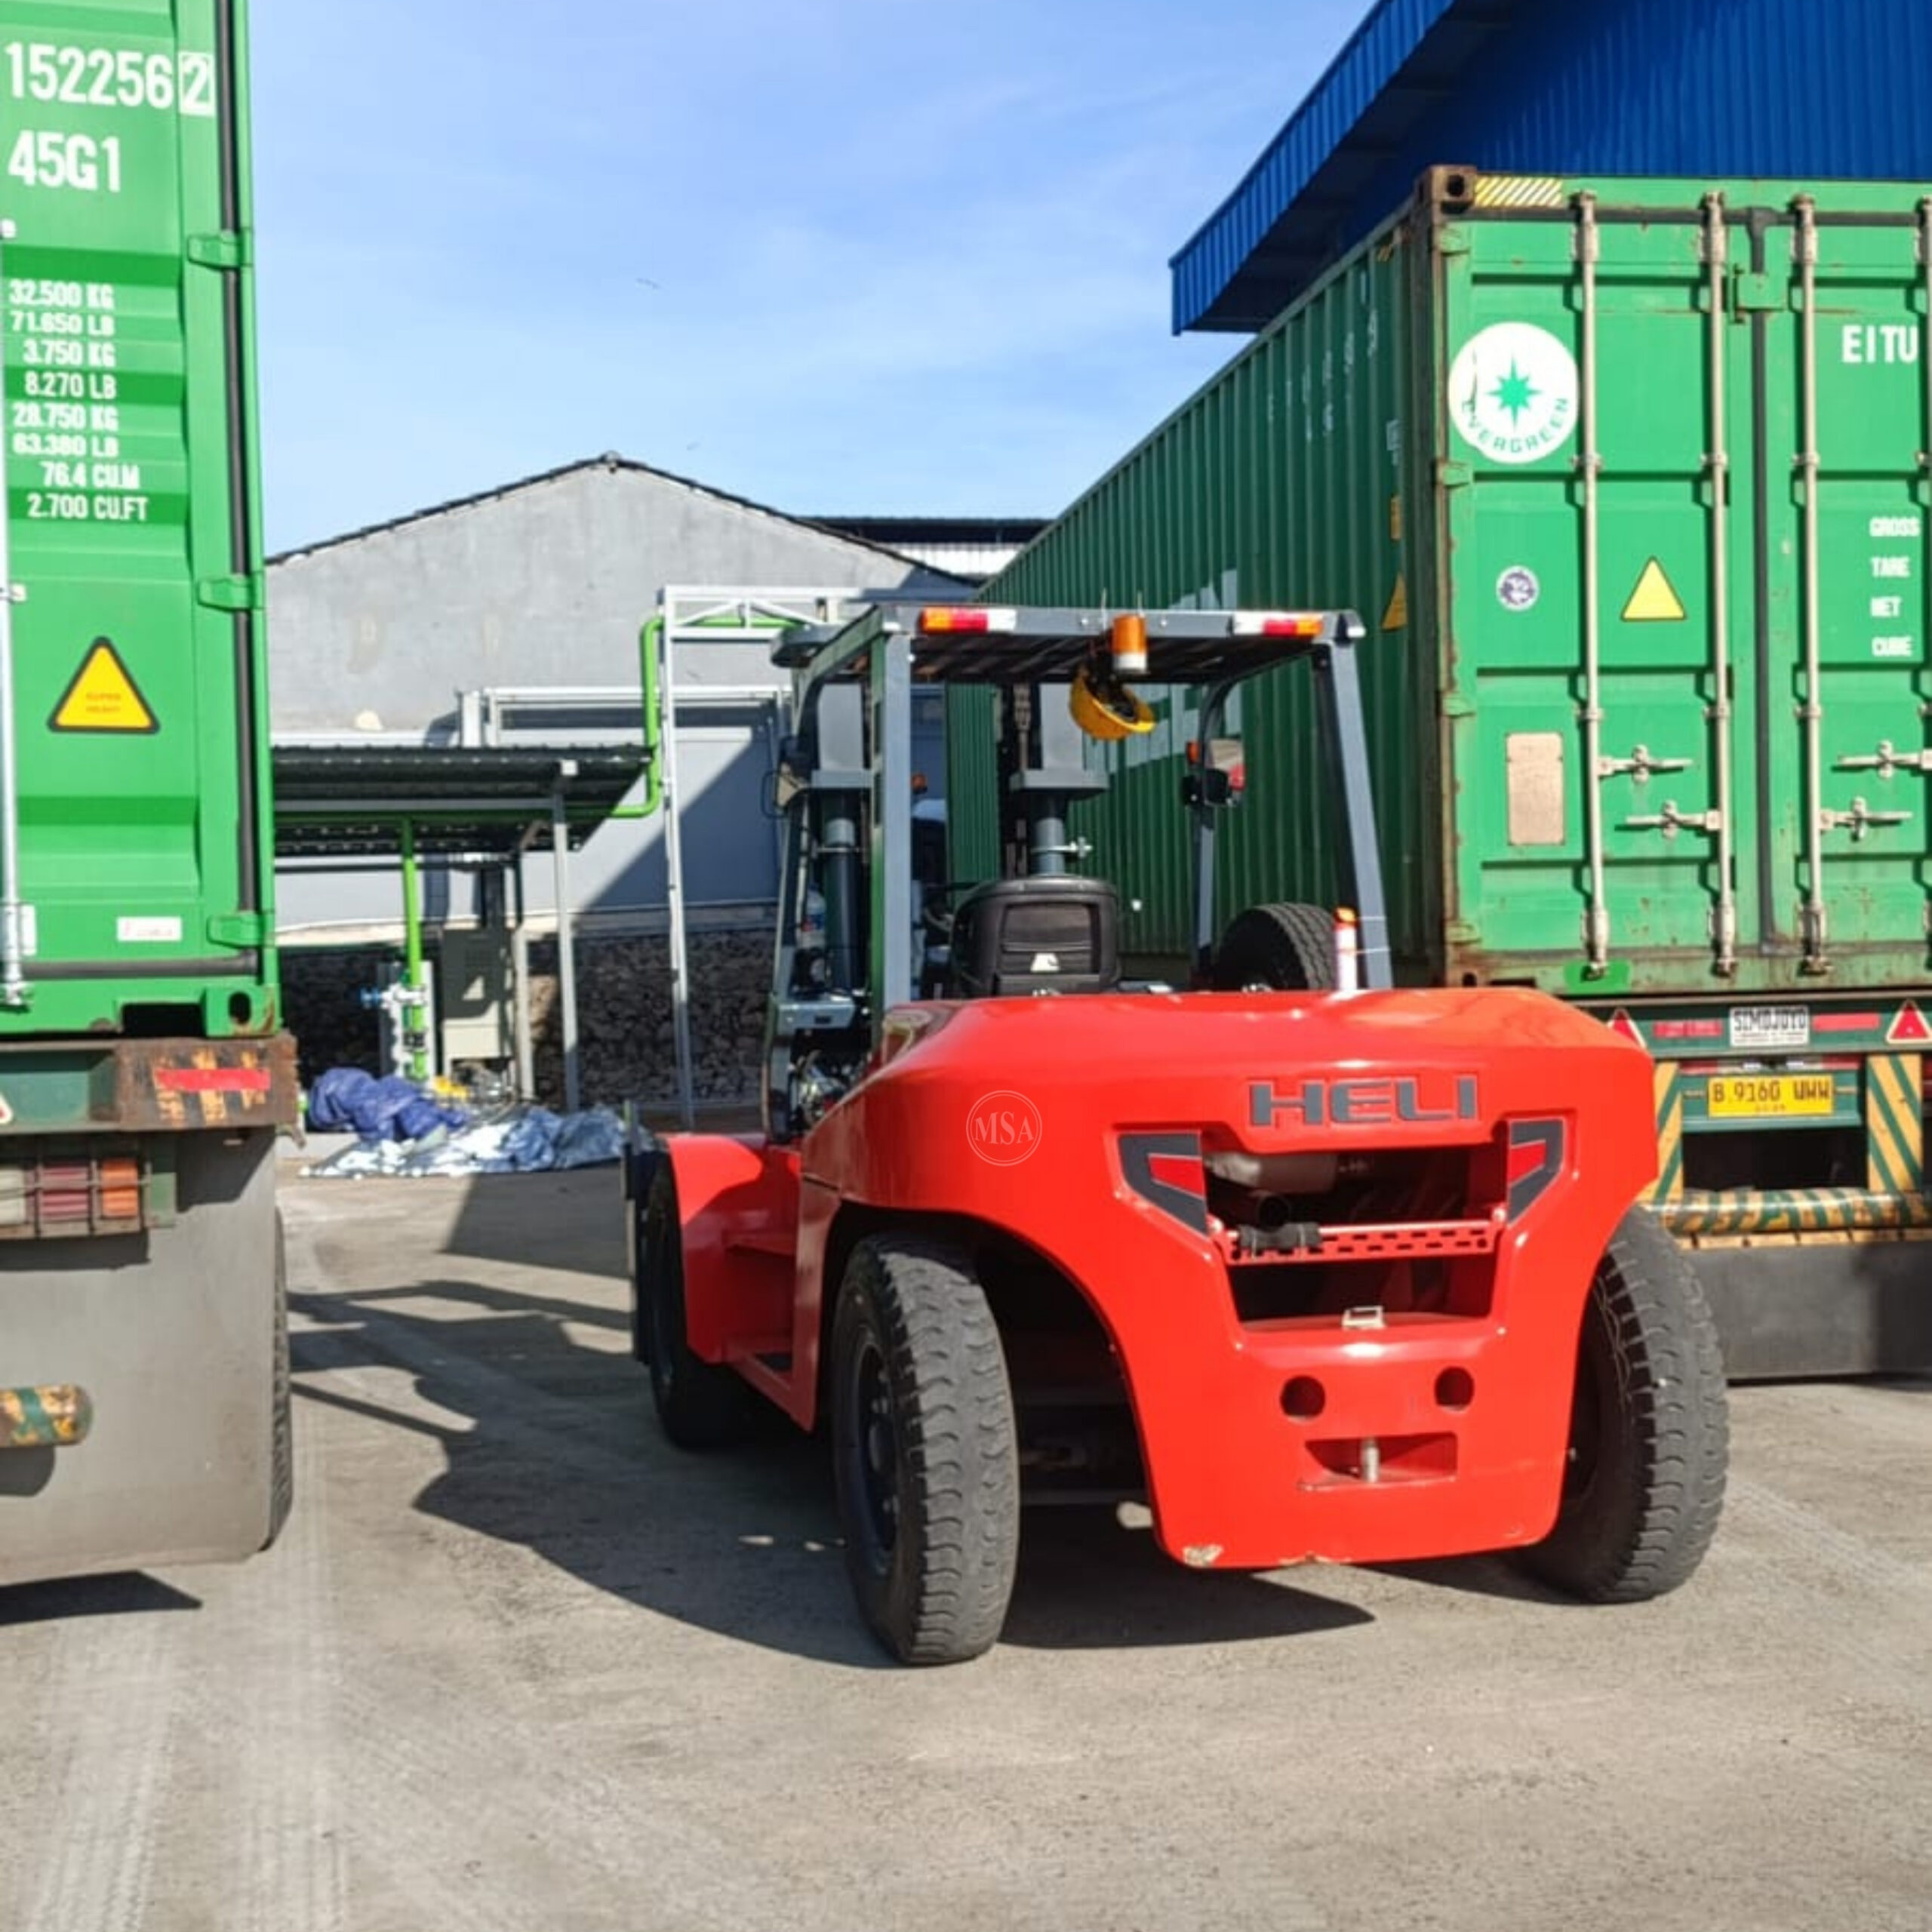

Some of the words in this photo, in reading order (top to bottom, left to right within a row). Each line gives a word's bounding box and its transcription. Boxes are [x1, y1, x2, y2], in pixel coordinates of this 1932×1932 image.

[5, 42, 174, 109] 152256
[8, 130, 121, 192] 45G1
[9, 280, 82, 307] 32.500
[87, 283, 115, 310] KG
[88, 315, 114, 337] LB
[23, 339, 82, 365] 3.750
[88, 343, 115, 368] KG
[1843, 325, 1918, 364] EITU
[25, 371, 85, 398] 8.270
[89, 373, 117, 400] LB
[12, 401, 87, 429] 28.750
[91, 405, 118, 432] KG
[91, 435, 118, 457] LB
[40, 460, 87, 488] 76.4
[27, 493, 88, 518] 2.700
[1249, 1075, 1477, 1126] HELI
[1713, 1081, 1725, 1103] B
